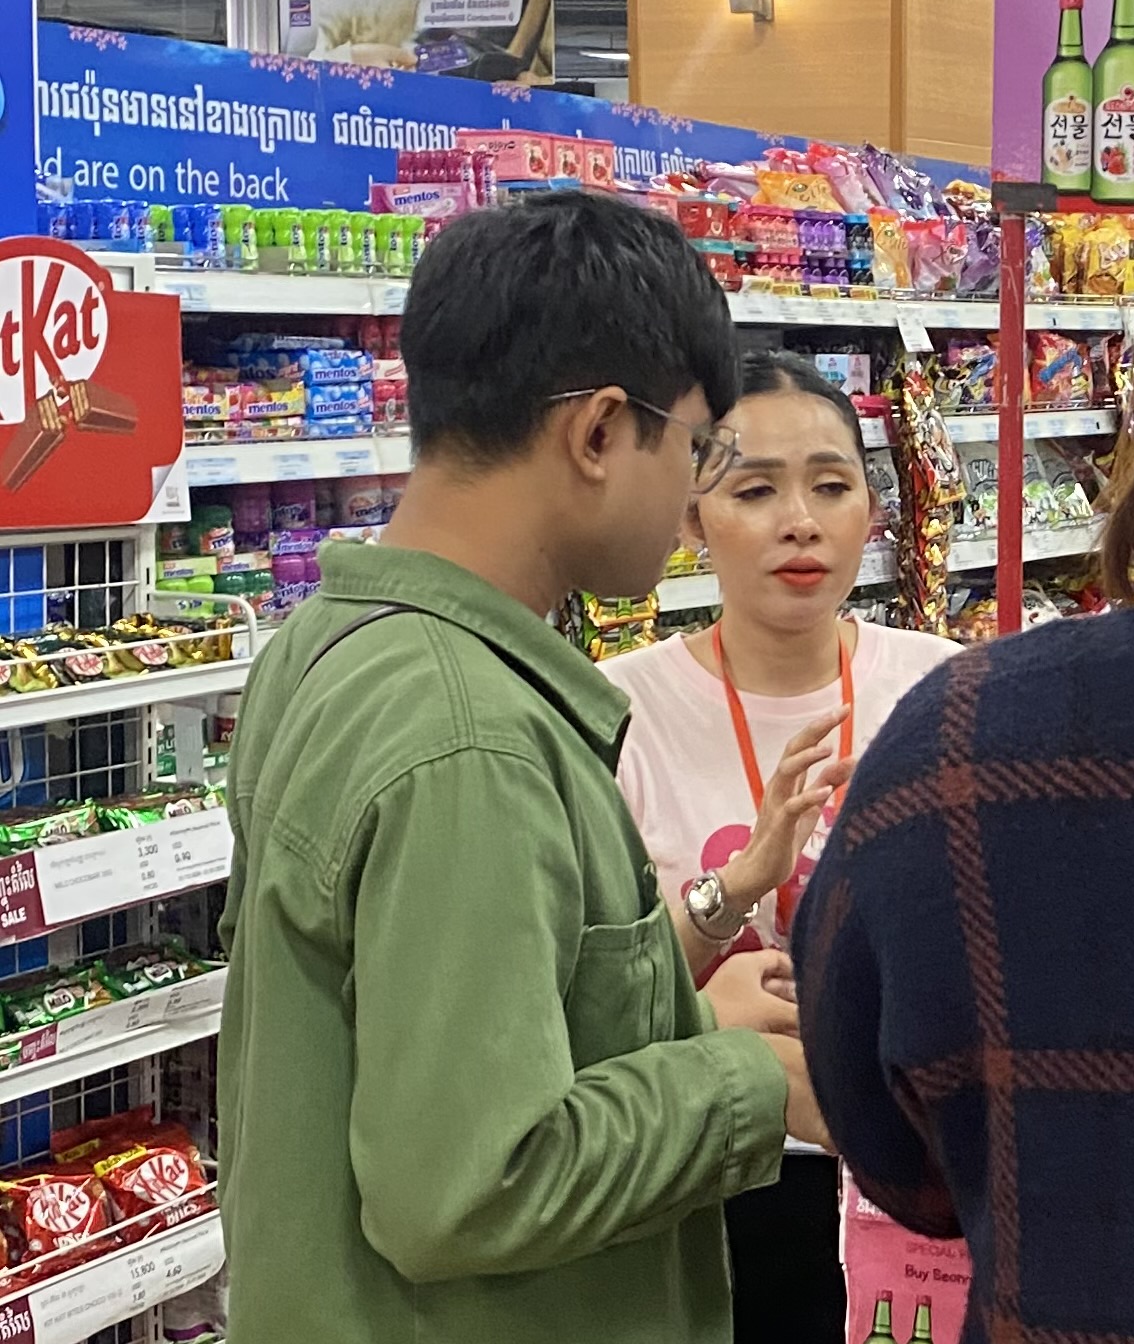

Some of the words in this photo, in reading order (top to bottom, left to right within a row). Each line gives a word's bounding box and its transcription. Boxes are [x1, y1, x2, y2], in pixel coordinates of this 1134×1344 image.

[1050, 114, 1088, 140] 선물
[74, 159, 119, 189] are
[129, 164, 165, 193] on
[175, 158, 220, 197] the
[229, 162, 290, 202] back
[394, 190, 440, 206] mentos
[0, 259, 100, 406] tKat
[314, 366, 357, 380] mentos
[248, 402, 288, 414] mentos
[315, 400, 357, 414] mentos
[1, 907, 26, 928] SALE
[905, 1264, 929, 1283] Buy
